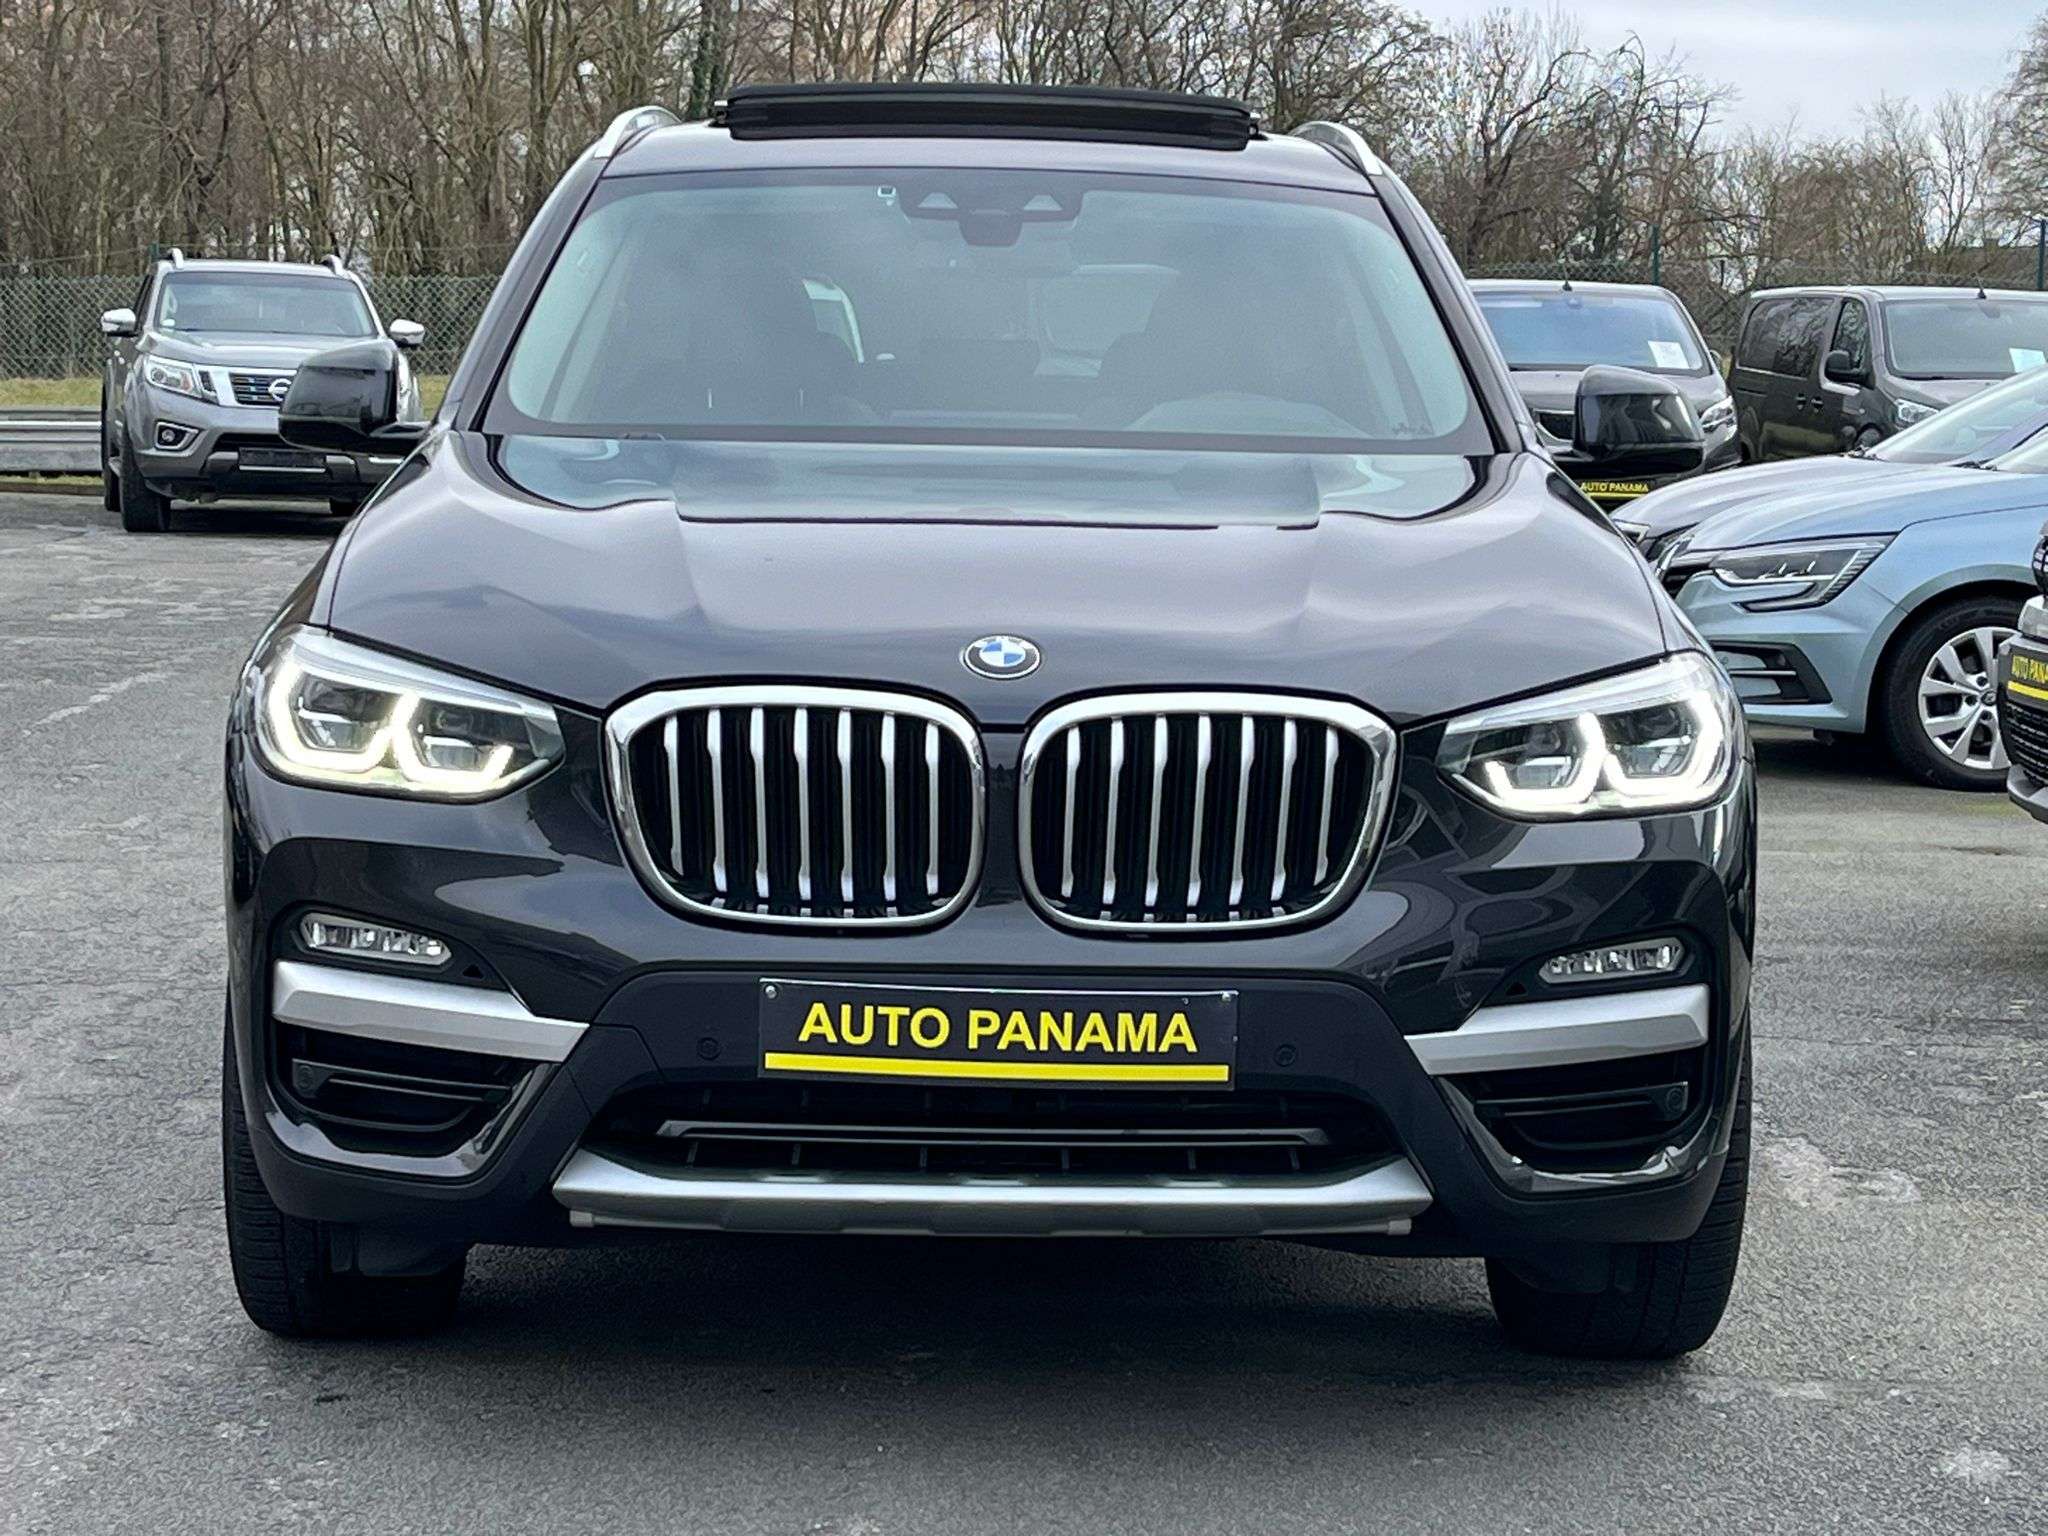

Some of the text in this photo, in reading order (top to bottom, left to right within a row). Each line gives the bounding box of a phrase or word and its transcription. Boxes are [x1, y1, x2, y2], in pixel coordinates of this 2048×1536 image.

[1580, 481, 1649, 493] AUTO PANAMA
[799, 1002, 1198, 1052] AUTO PANAMA
